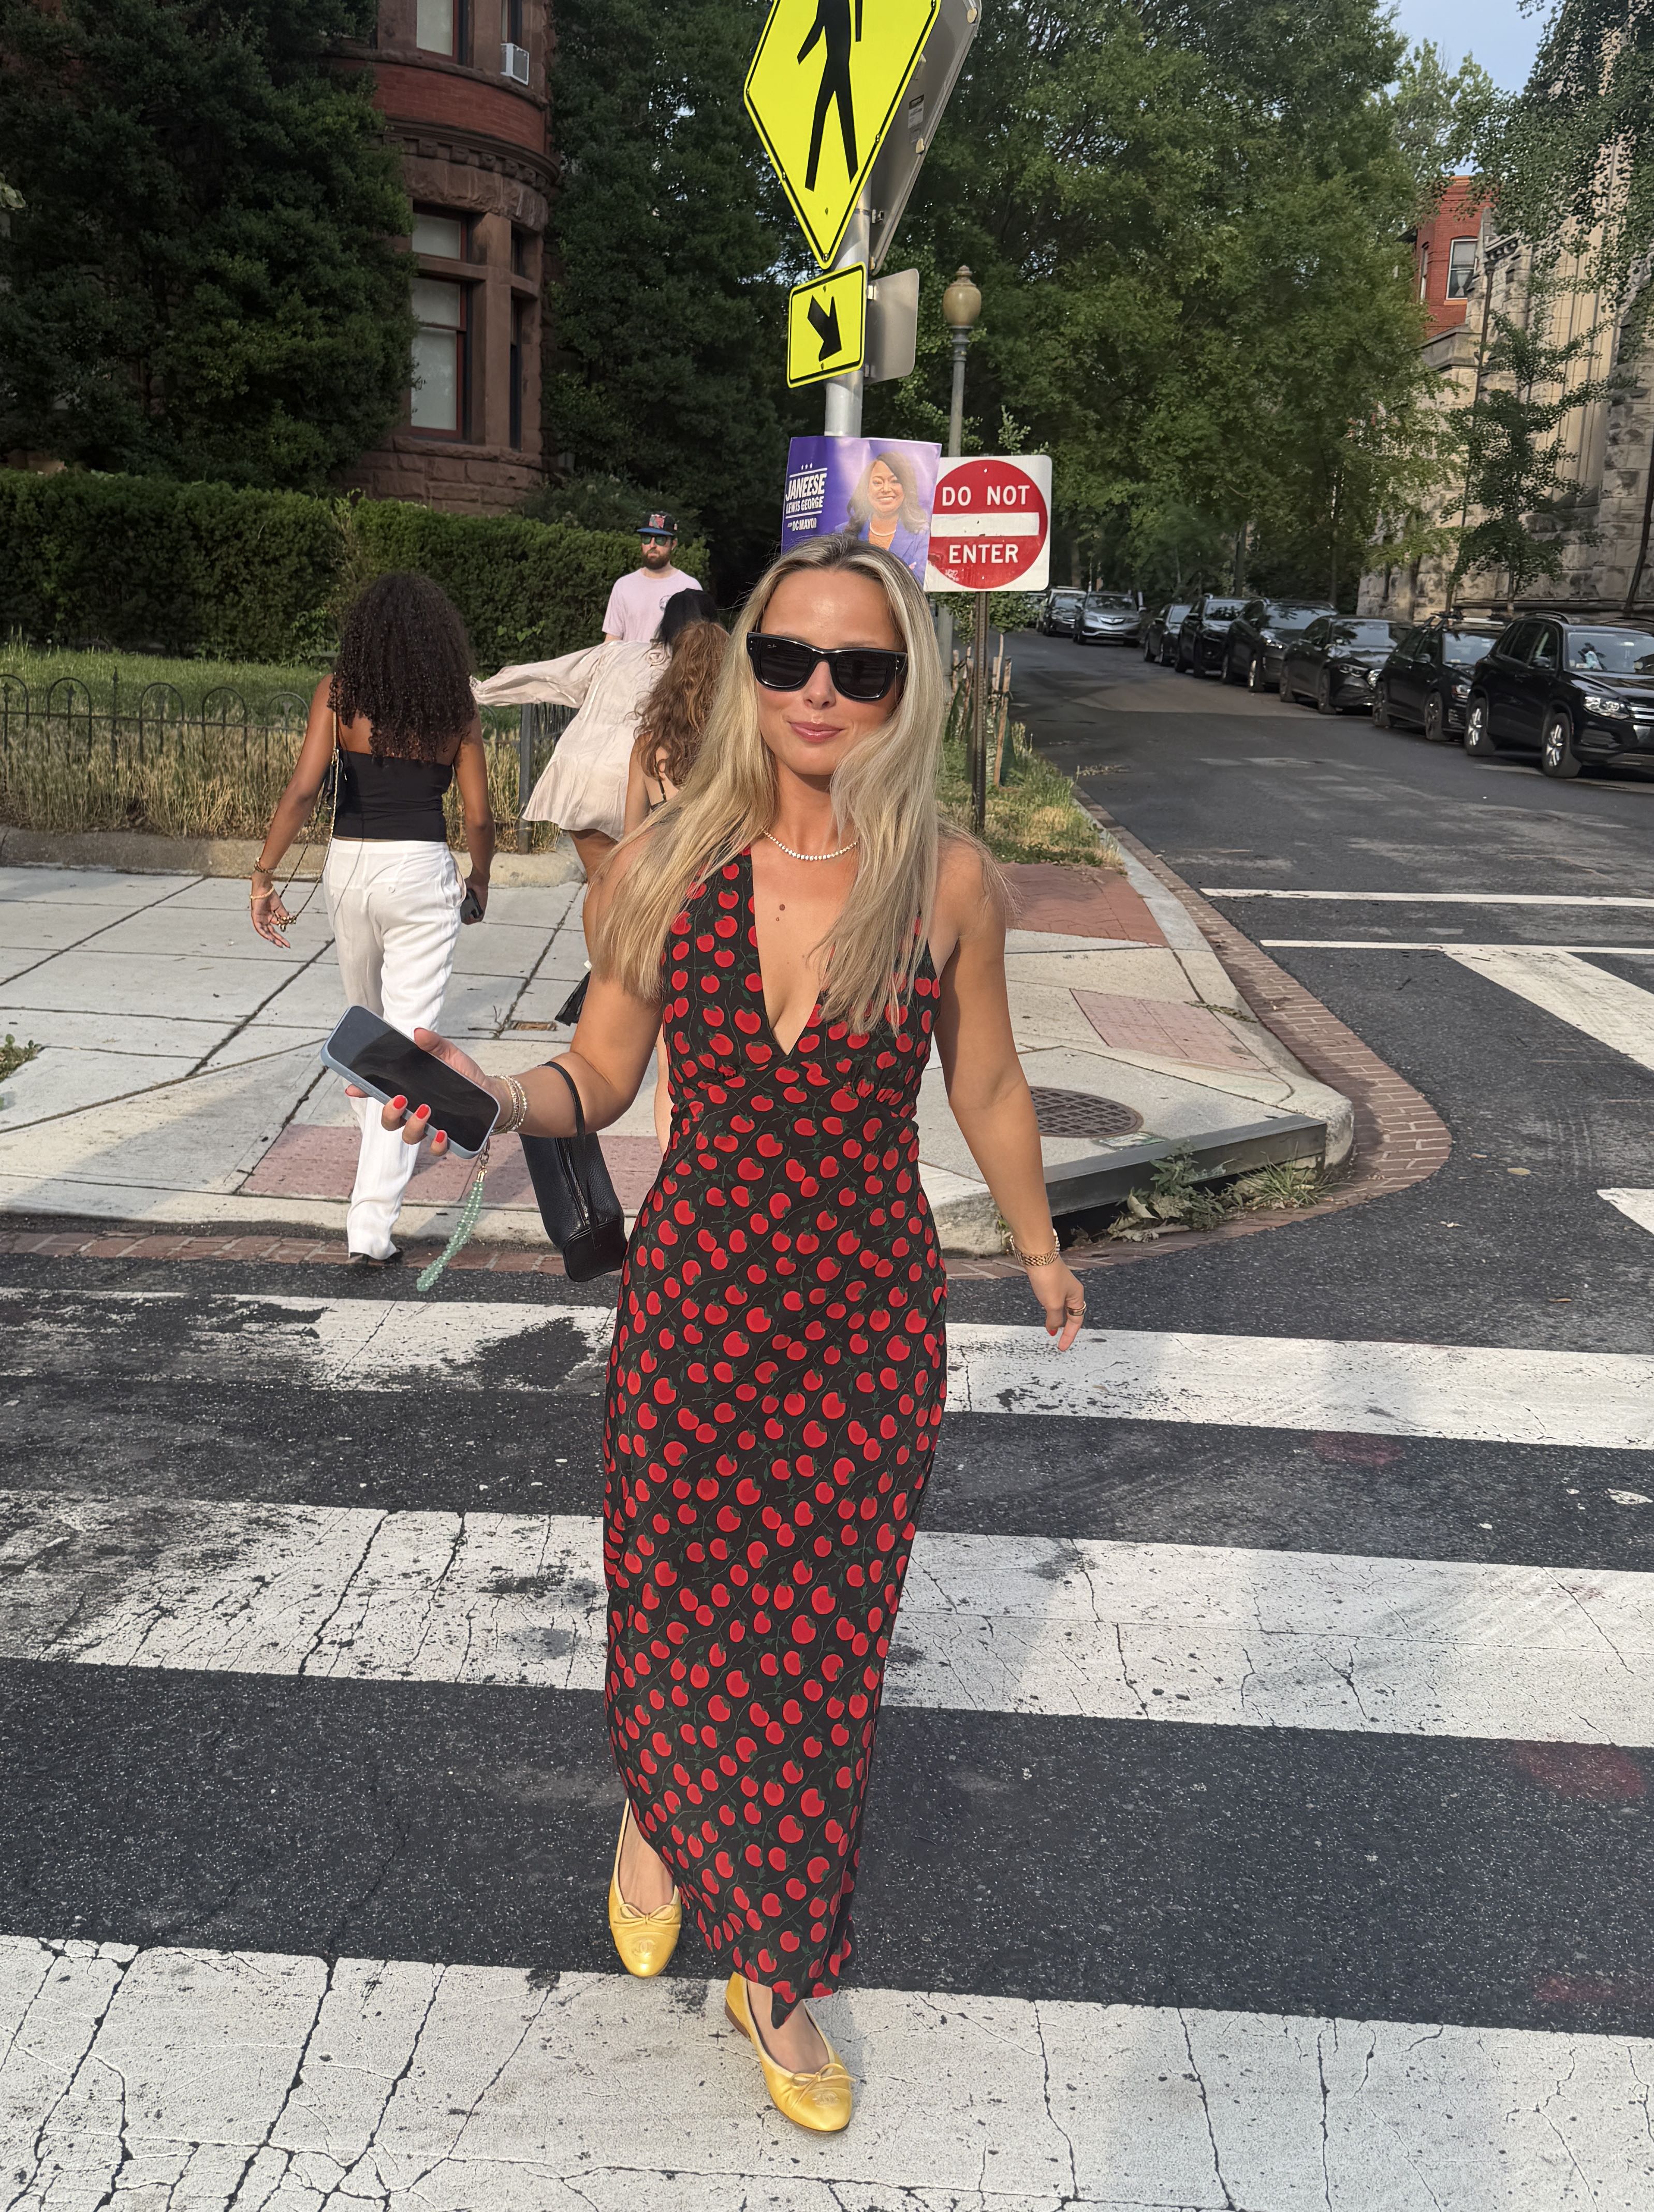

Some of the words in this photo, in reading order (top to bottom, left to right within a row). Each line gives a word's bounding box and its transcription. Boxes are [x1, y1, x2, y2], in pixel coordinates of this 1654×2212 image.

[785, 473, 827, 501] JANEESE
[942, 486, 971, 506] DO
[987, 485, 1030, 505] NOT
[786, 500, 800, 514] LEWIS
[801, 496, 824, 511] GEORGE
[793, 520, 799, 531] DC
[799, 518, 817, 530] MAYOR
[949, 544, 1018, 564] ENTER
